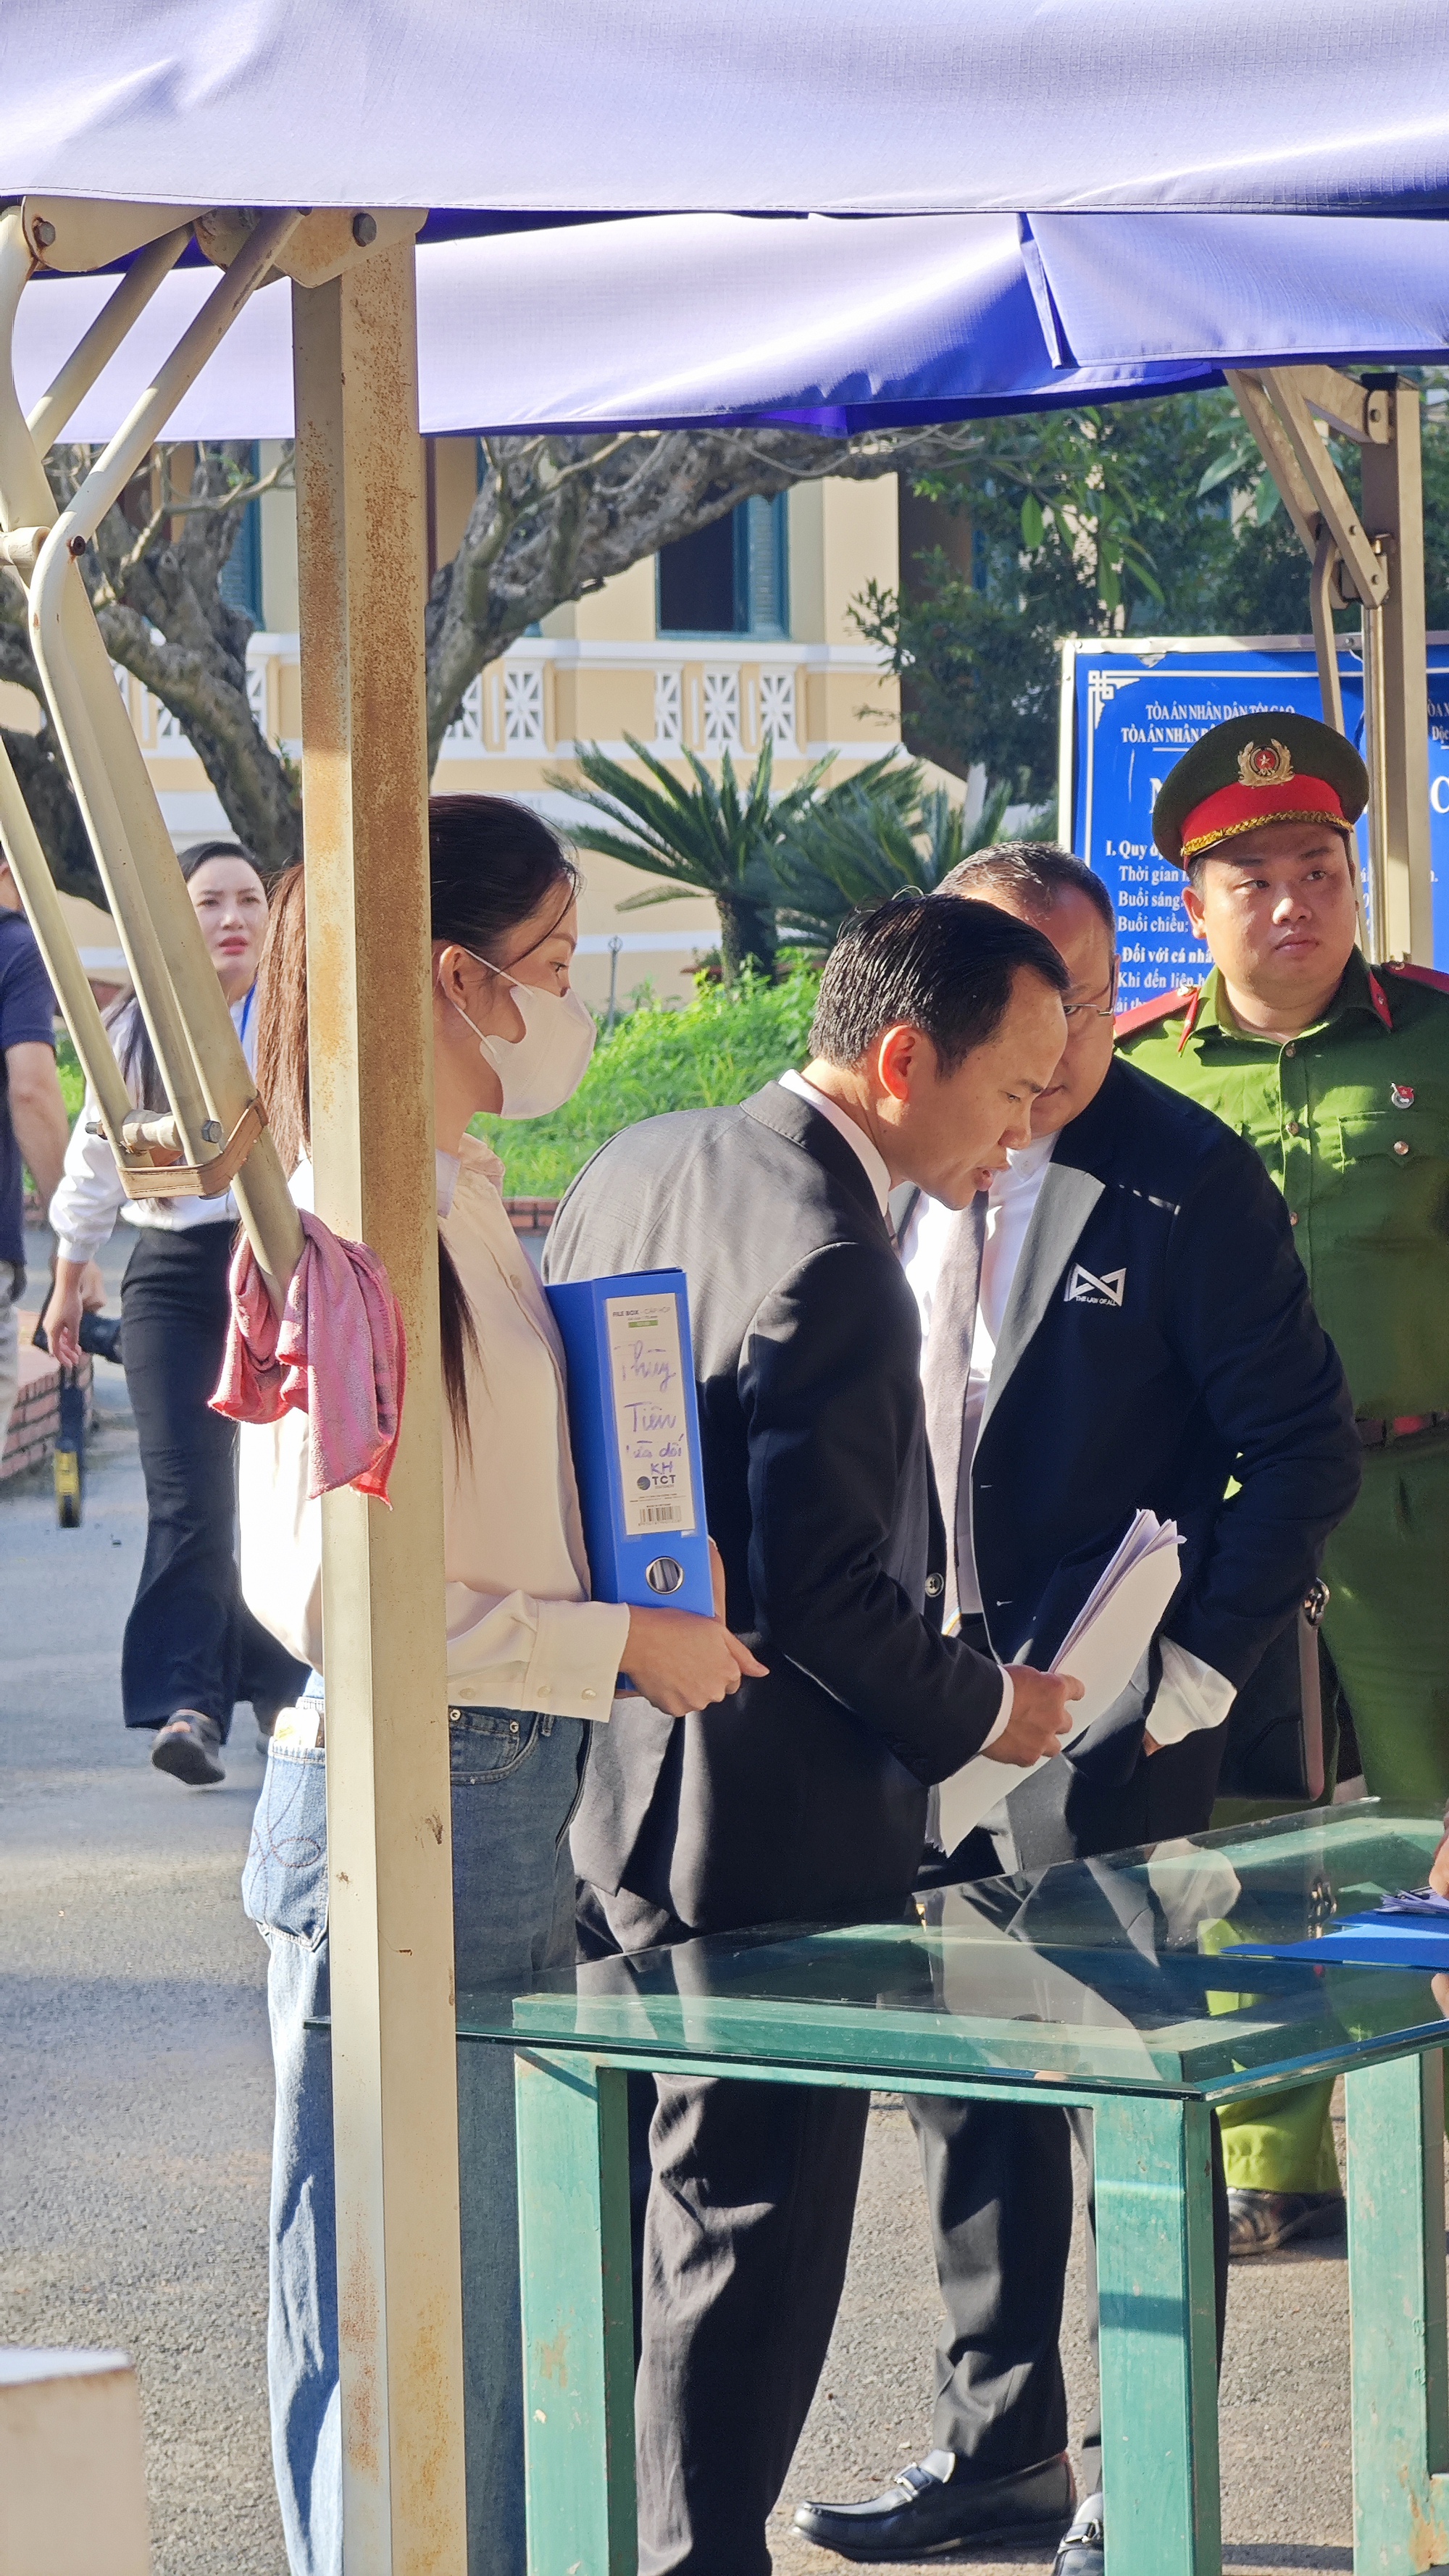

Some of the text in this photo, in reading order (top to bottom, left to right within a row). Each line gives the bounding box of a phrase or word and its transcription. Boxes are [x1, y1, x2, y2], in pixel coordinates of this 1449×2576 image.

[1188, 701, 1222, 720] NHÂN
[1223, 701, 1248, 721] DÂN
[1165, 723, 1200, 743] NHÂN
[1106, 840, 1116, 856] I.
[1119, 840, 1148, 861] Quy
[1119, 864, 1149, 882] Thời
[1151, 865, 1179, 887] gian
[1118, 887, 1149, 907] Buổi
[1118, 912, 1148, 932] Buổi
[1122, 942, 1146, 963] Đối
[1148, 947, 1169, 963] với
[1171, 948, 1187, 963] cá
[1118, 971, 1141, 988] Khi
[1143, 969, 1166, 988] đến
[650, 1460, 674, 1476] KH
[651, 1474, 676, 1486] TCT
